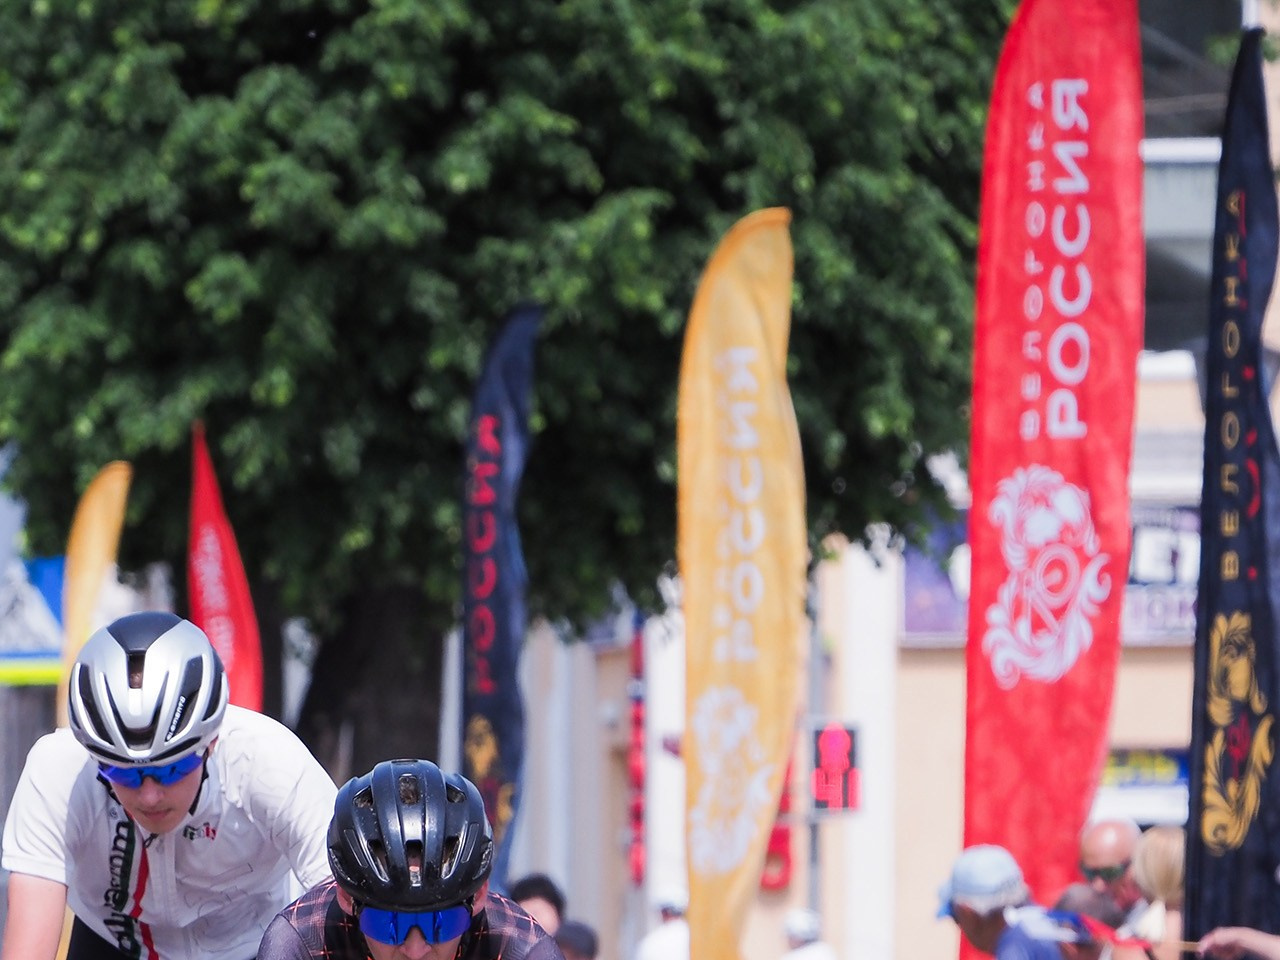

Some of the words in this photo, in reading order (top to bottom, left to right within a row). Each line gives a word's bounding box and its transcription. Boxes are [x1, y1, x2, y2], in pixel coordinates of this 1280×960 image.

[1019, 81, 1048, 442] ВЕЛОГОНКА
[1046, 78, 1093, 441] РОССИЯ
[1220, 190, 1243, 581] ВЕЛОГОНКА
[725, 346, 766, 663] РОССИЯ
